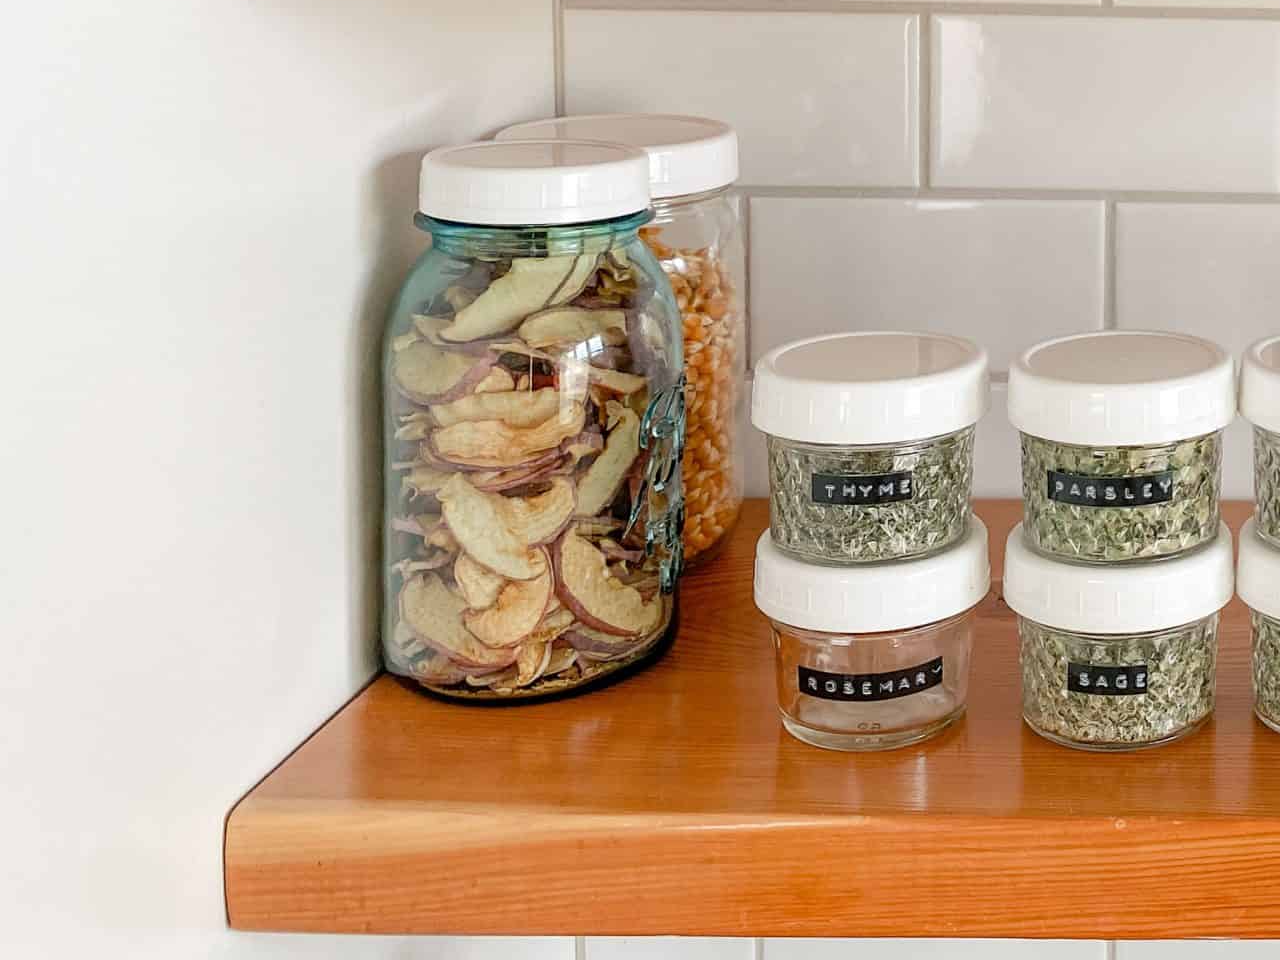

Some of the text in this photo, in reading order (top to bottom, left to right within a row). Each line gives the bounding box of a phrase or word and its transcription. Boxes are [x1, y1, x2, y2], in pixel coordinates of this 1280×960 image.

[825, 480, 910, 498] THYME
[1055, 478, 1171, 500] PARSLEY
[1079, 672, 1146, 688] SAGE
